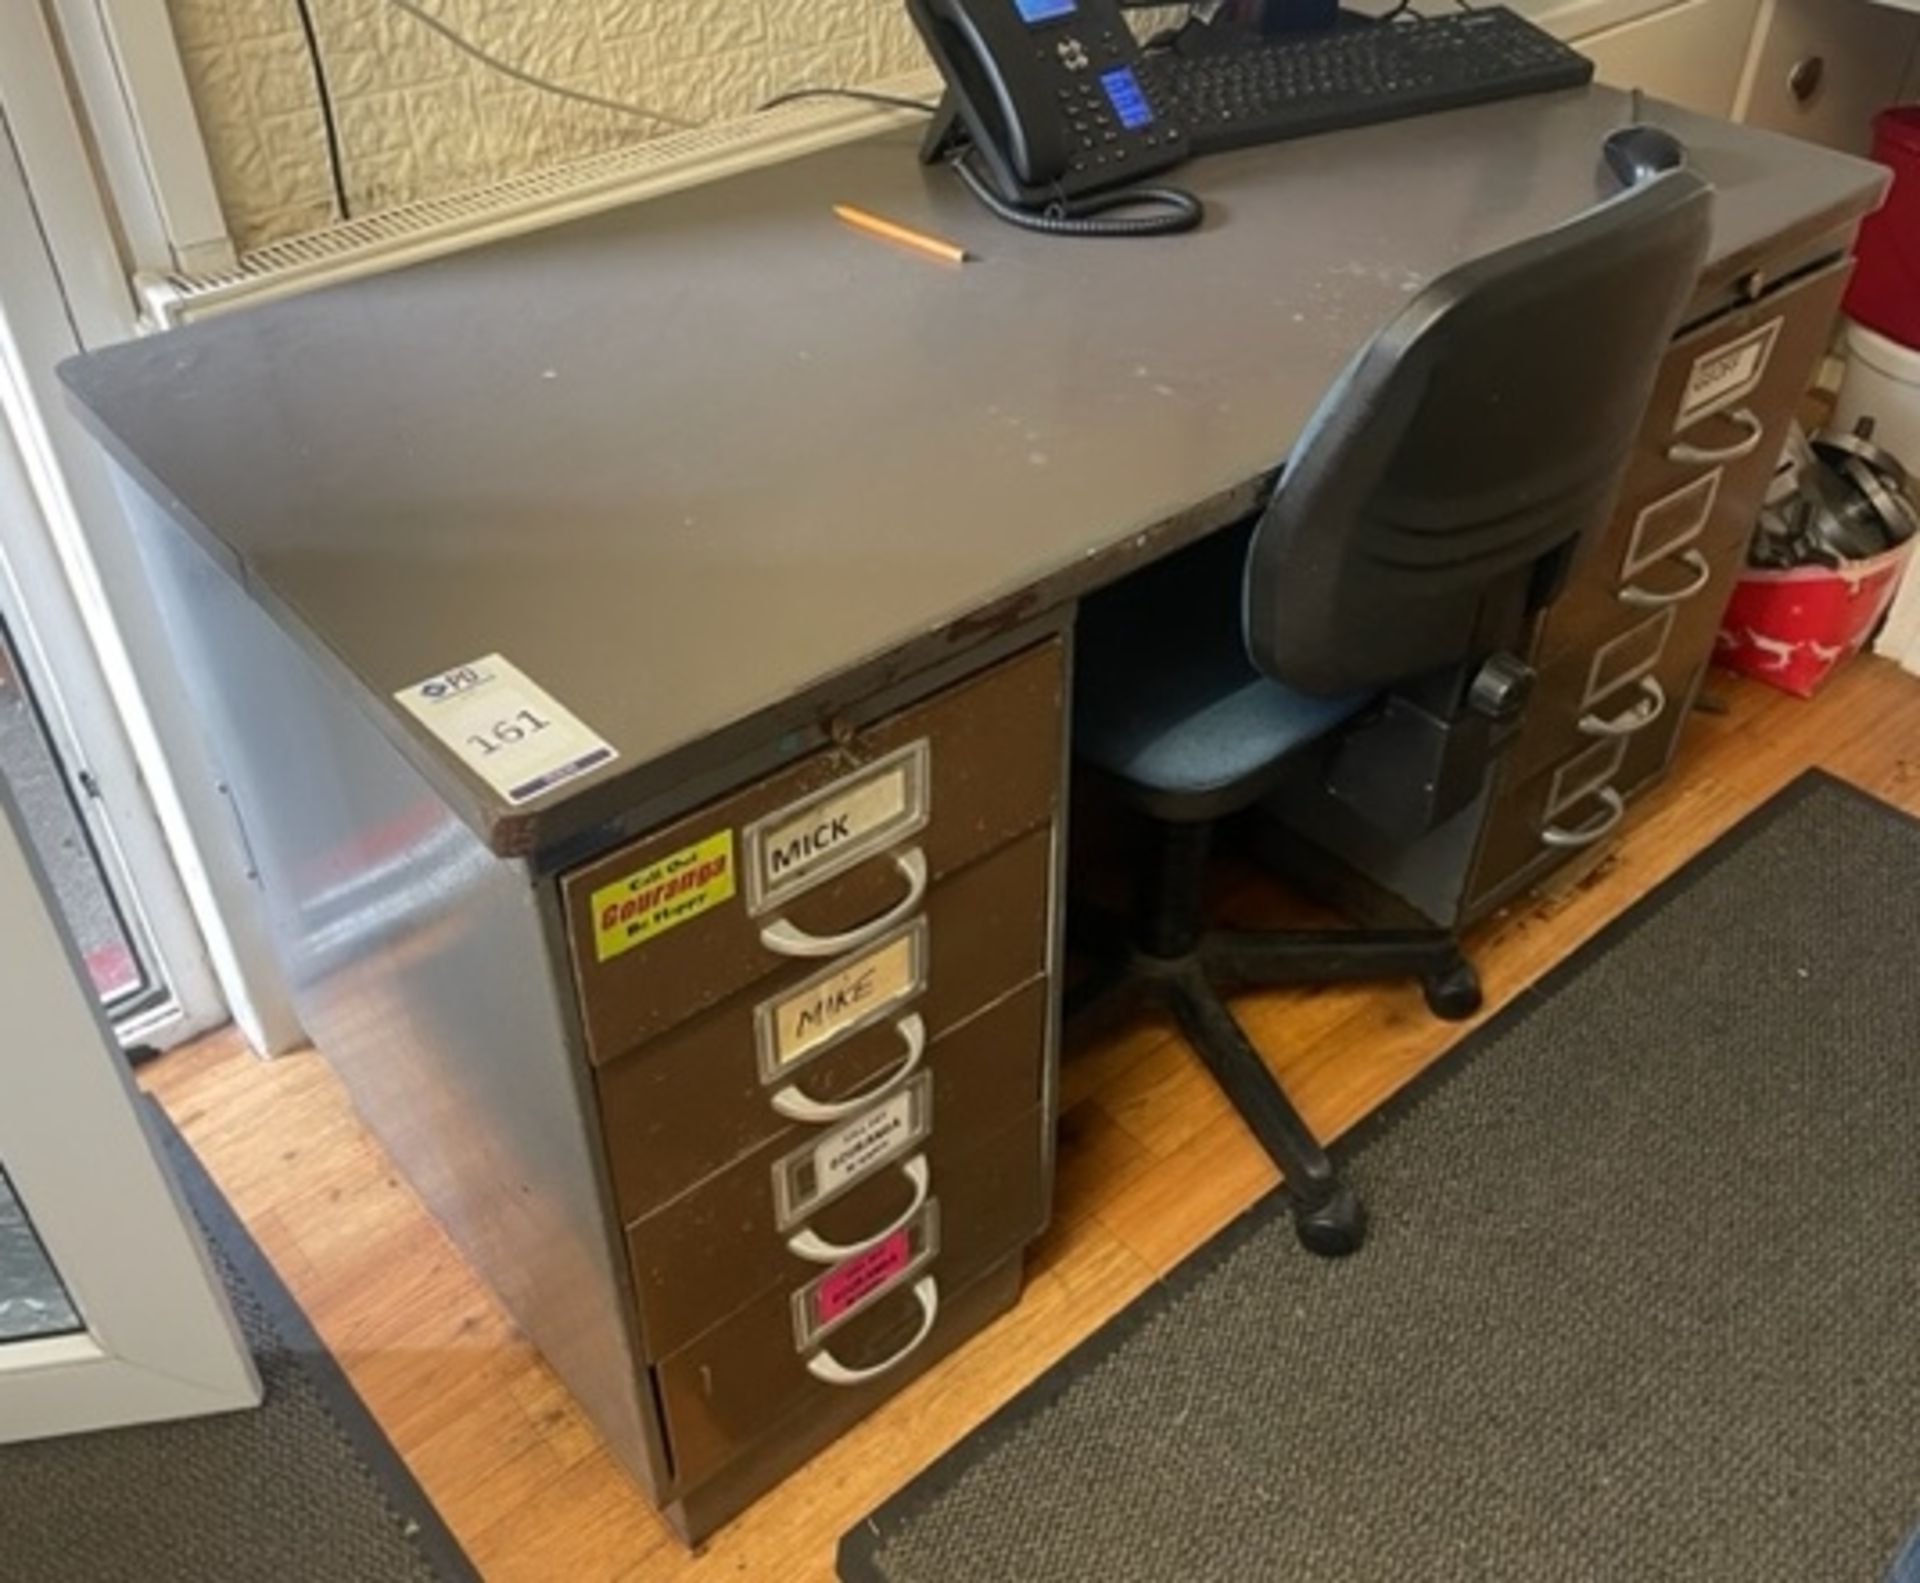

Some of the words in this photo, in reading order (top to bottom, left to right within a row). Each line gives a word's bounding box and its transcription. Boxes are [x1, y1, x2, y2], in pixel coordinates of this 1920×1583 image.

[467, 709, 550, 755] 161
[771, 813, 849, 873] MICK
[601, 854, 727, 932] Gouranga
[795, 965, 877, 1038] MIKE
